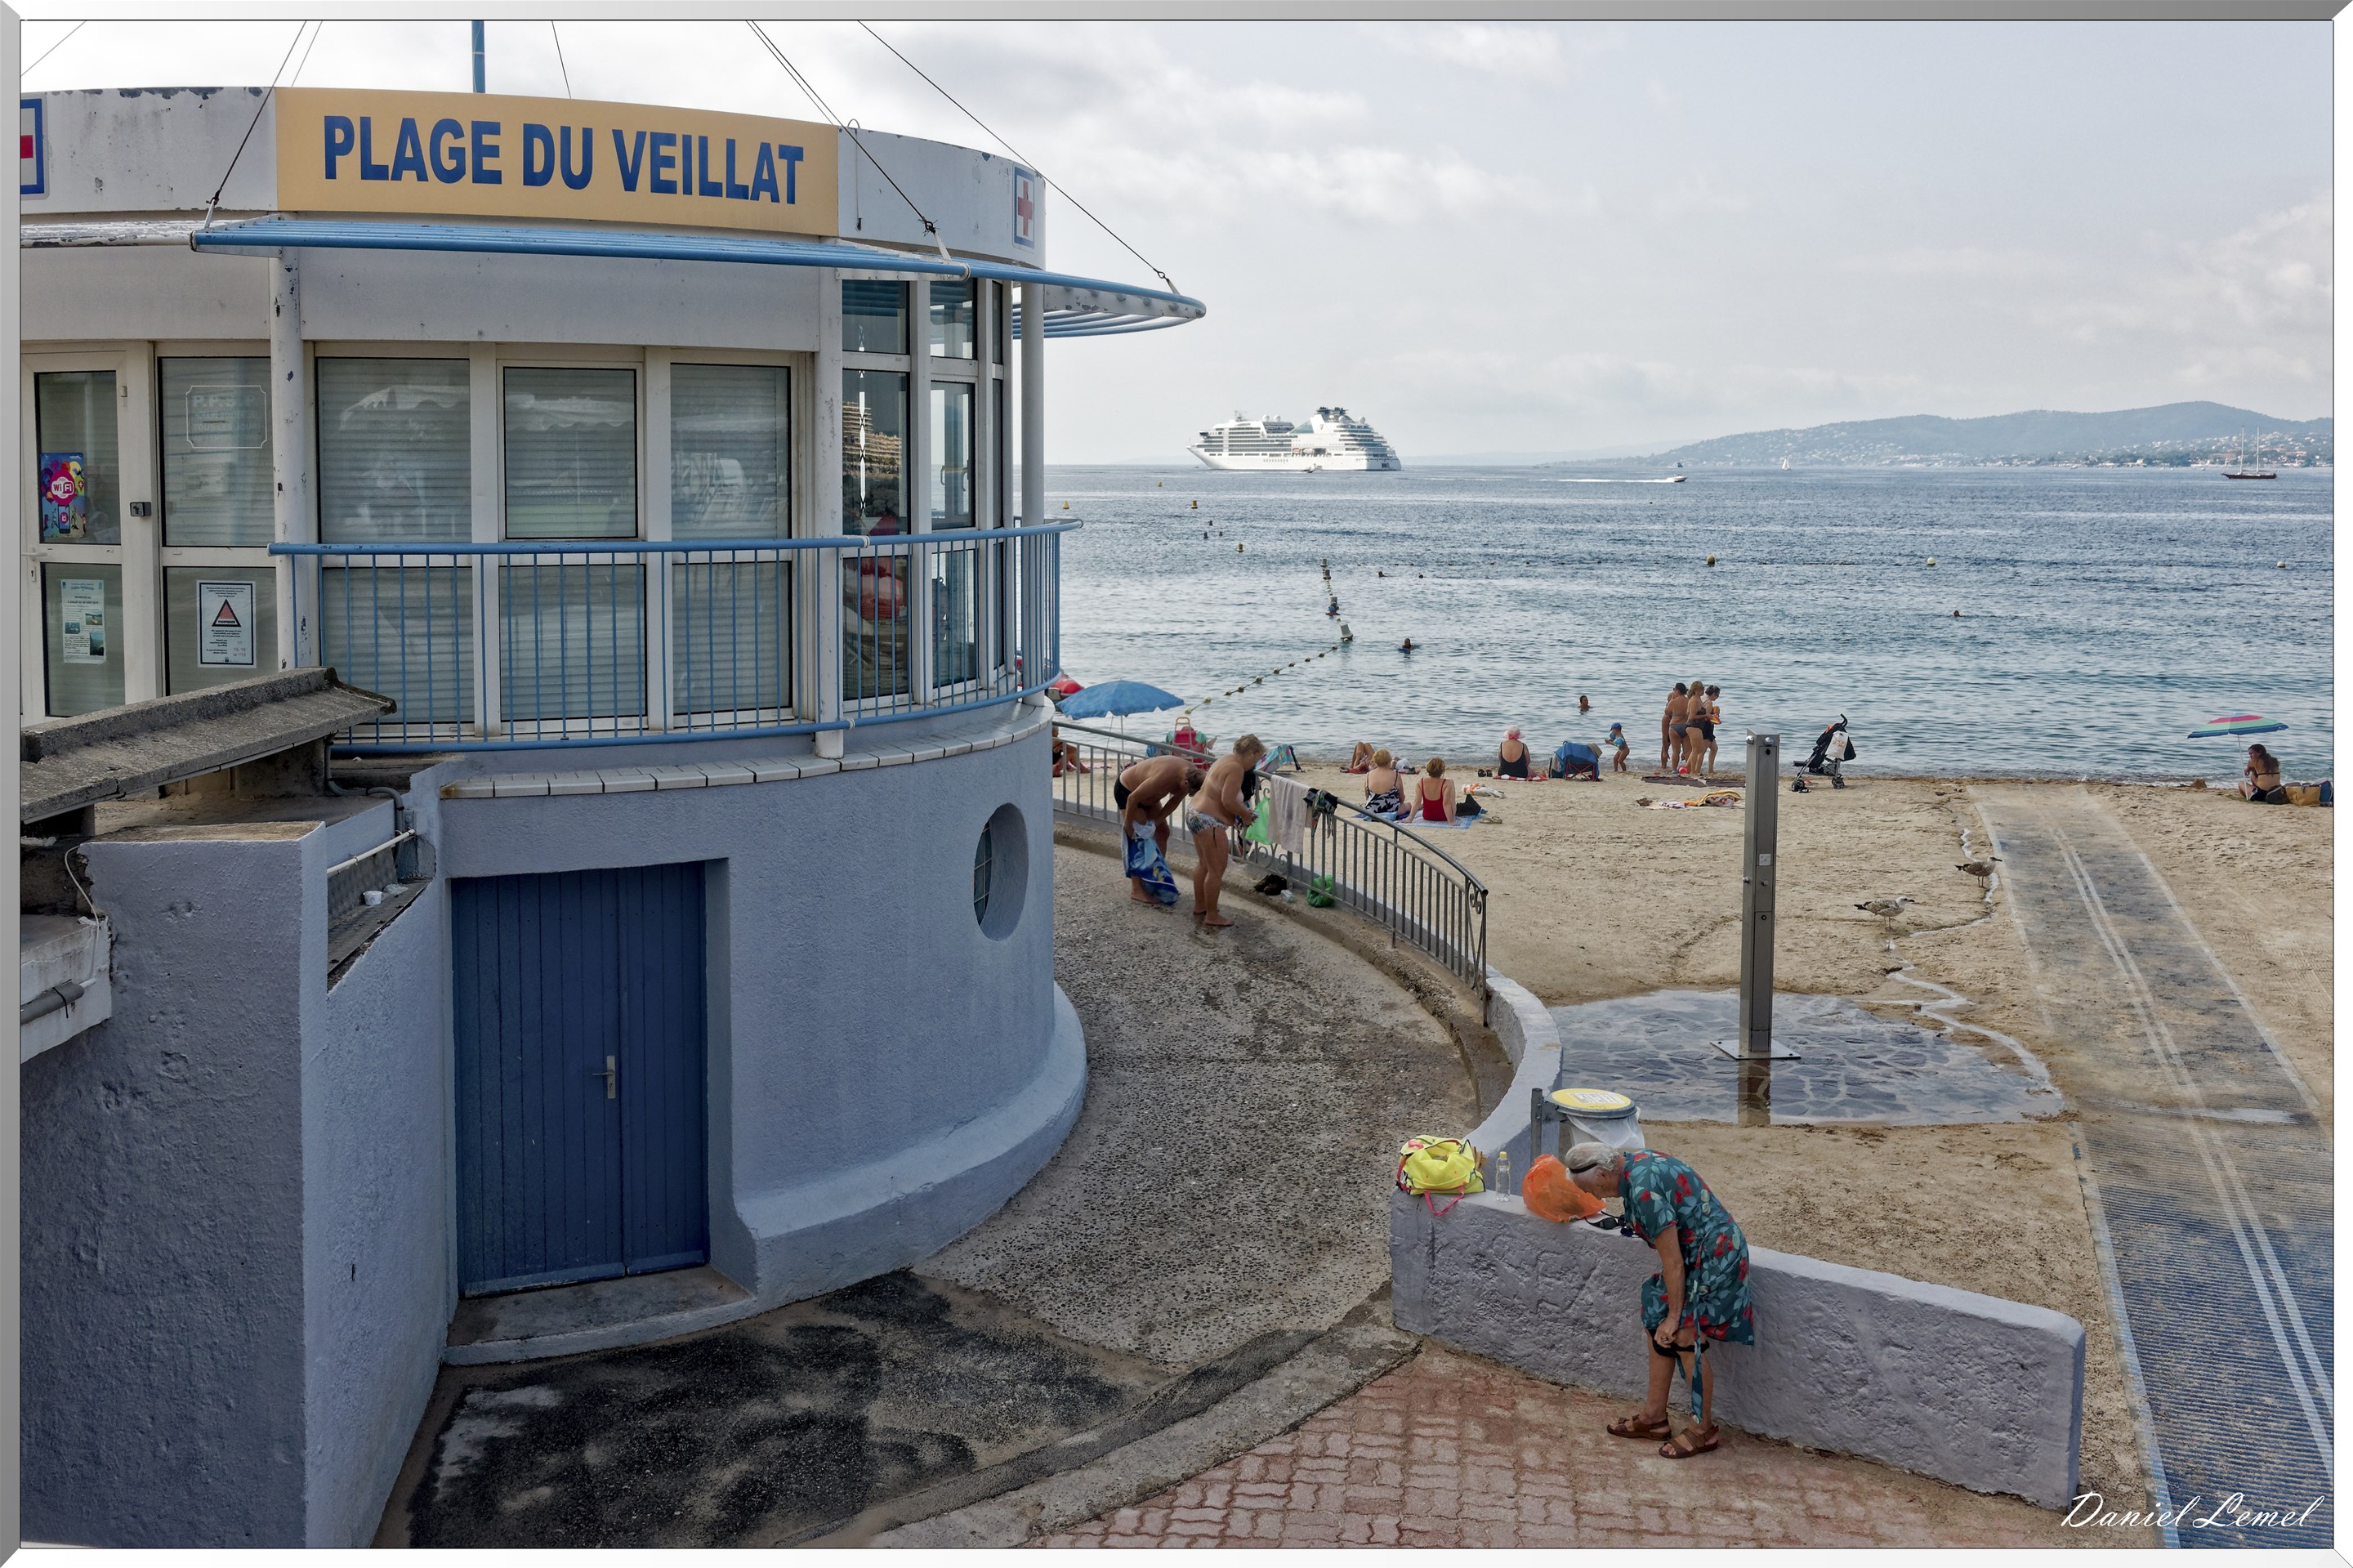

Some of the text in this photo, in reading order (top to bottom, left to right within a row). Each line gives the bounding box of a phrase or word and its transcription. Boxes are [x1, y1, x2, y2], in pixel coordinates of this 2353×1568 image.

[324, 116, 804, 204] PLAGE DU VEILLAT
